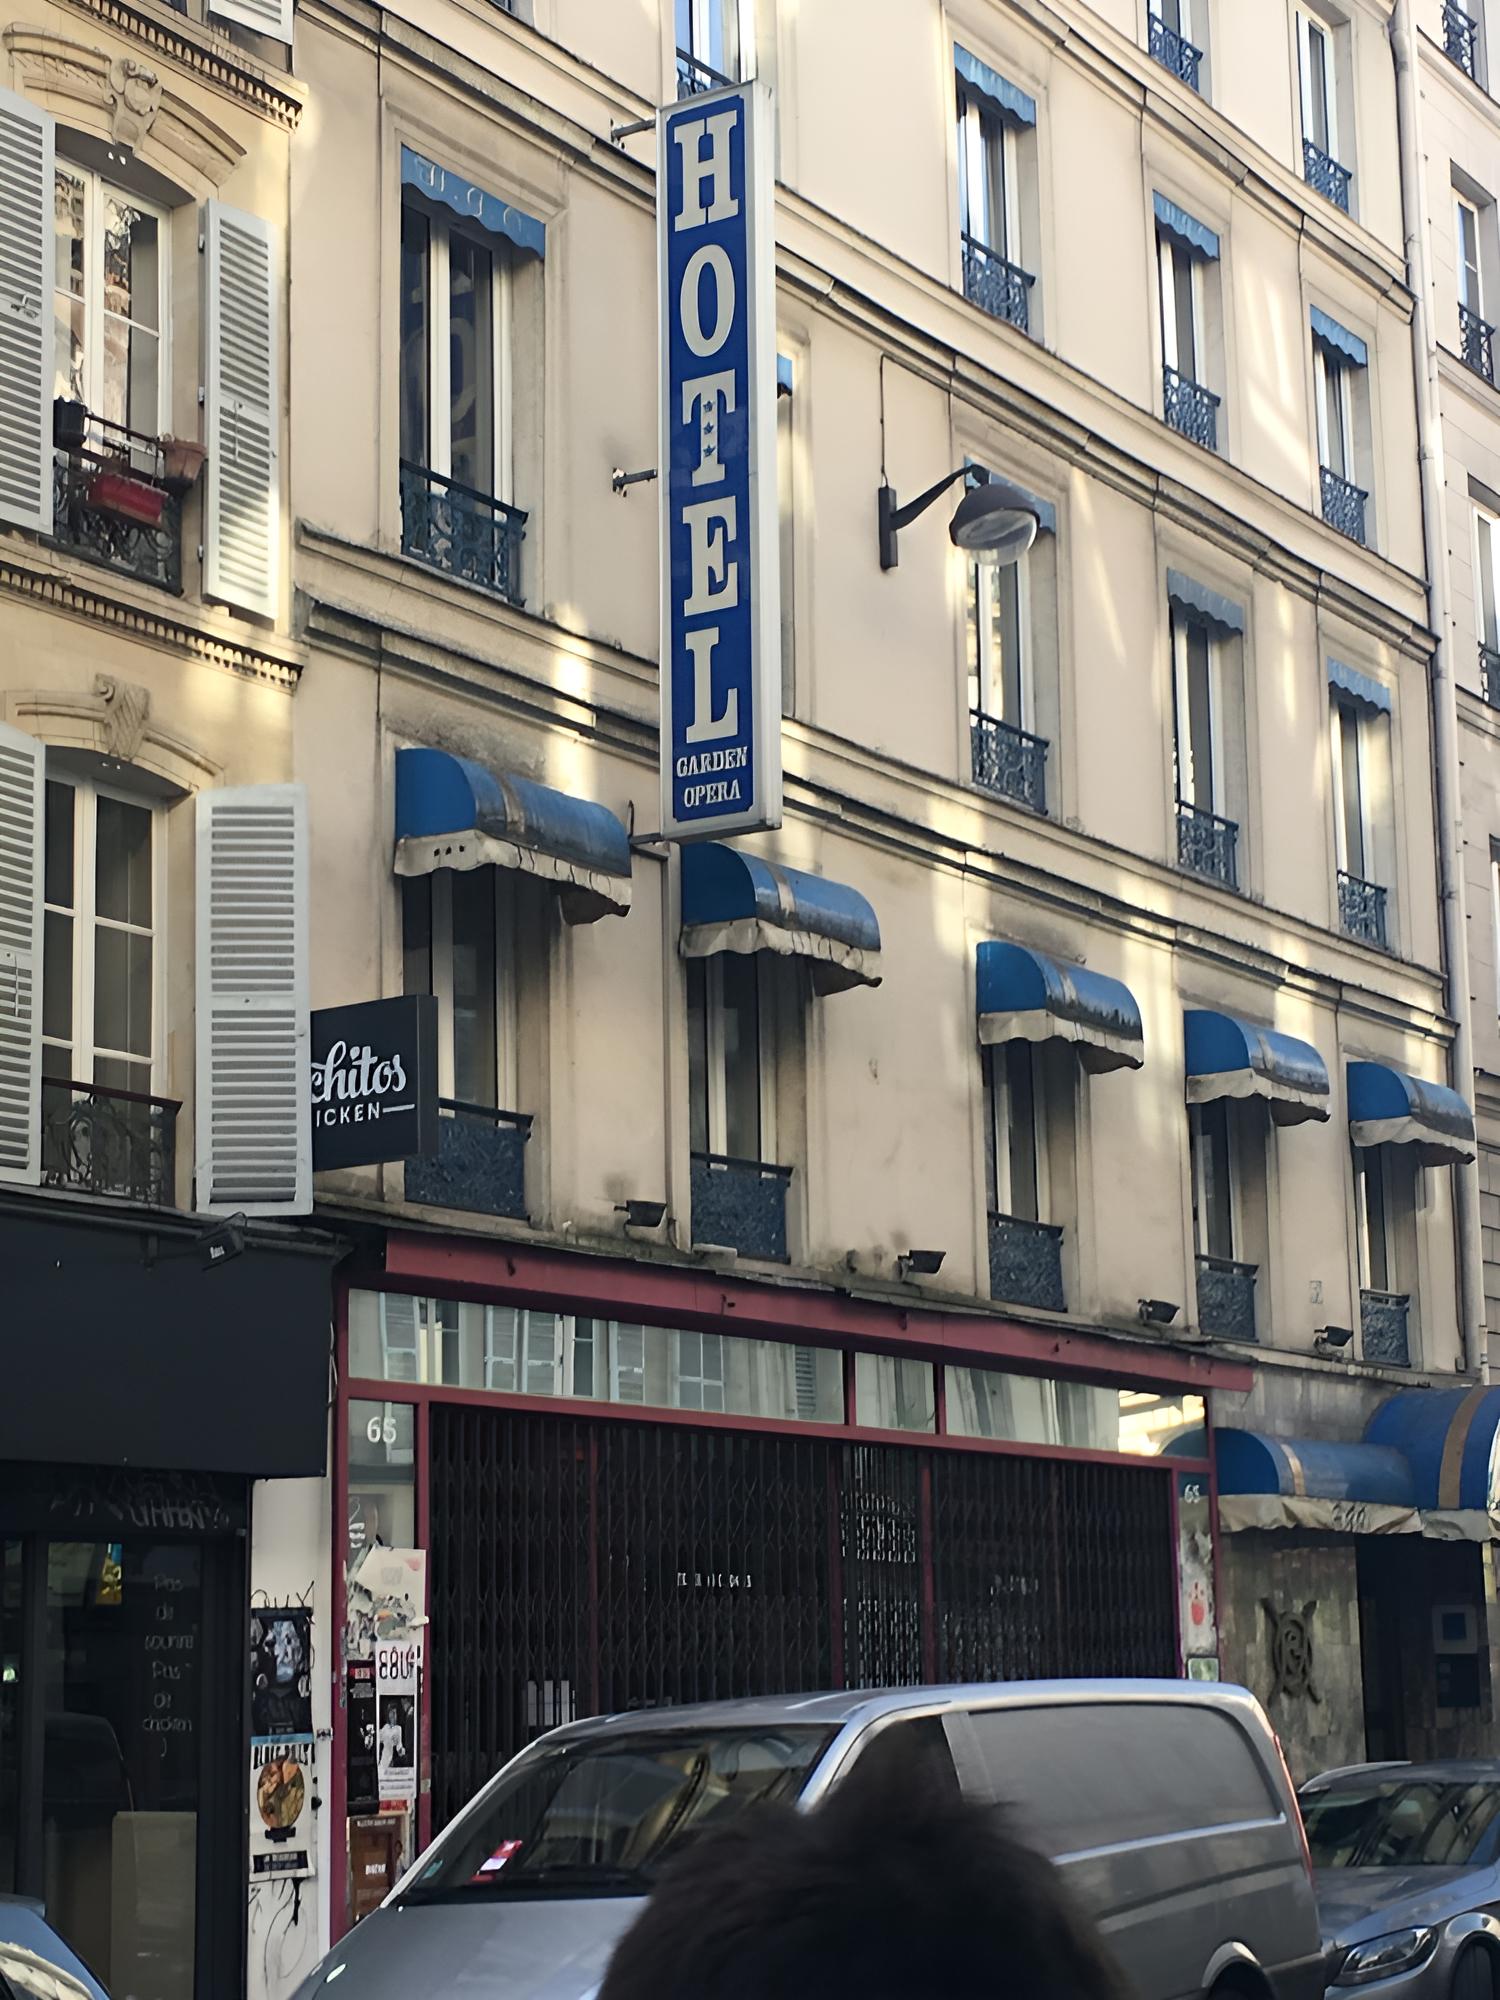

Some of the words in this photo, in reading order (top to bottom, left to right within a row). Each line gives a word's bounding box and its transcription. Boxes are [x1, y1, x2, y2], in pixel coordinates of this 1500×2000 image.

[674, 109, 739, 744] HOTEL
[676, 746, 748, 777] GARDEN
[683, 779, 741, 808] OPERA
